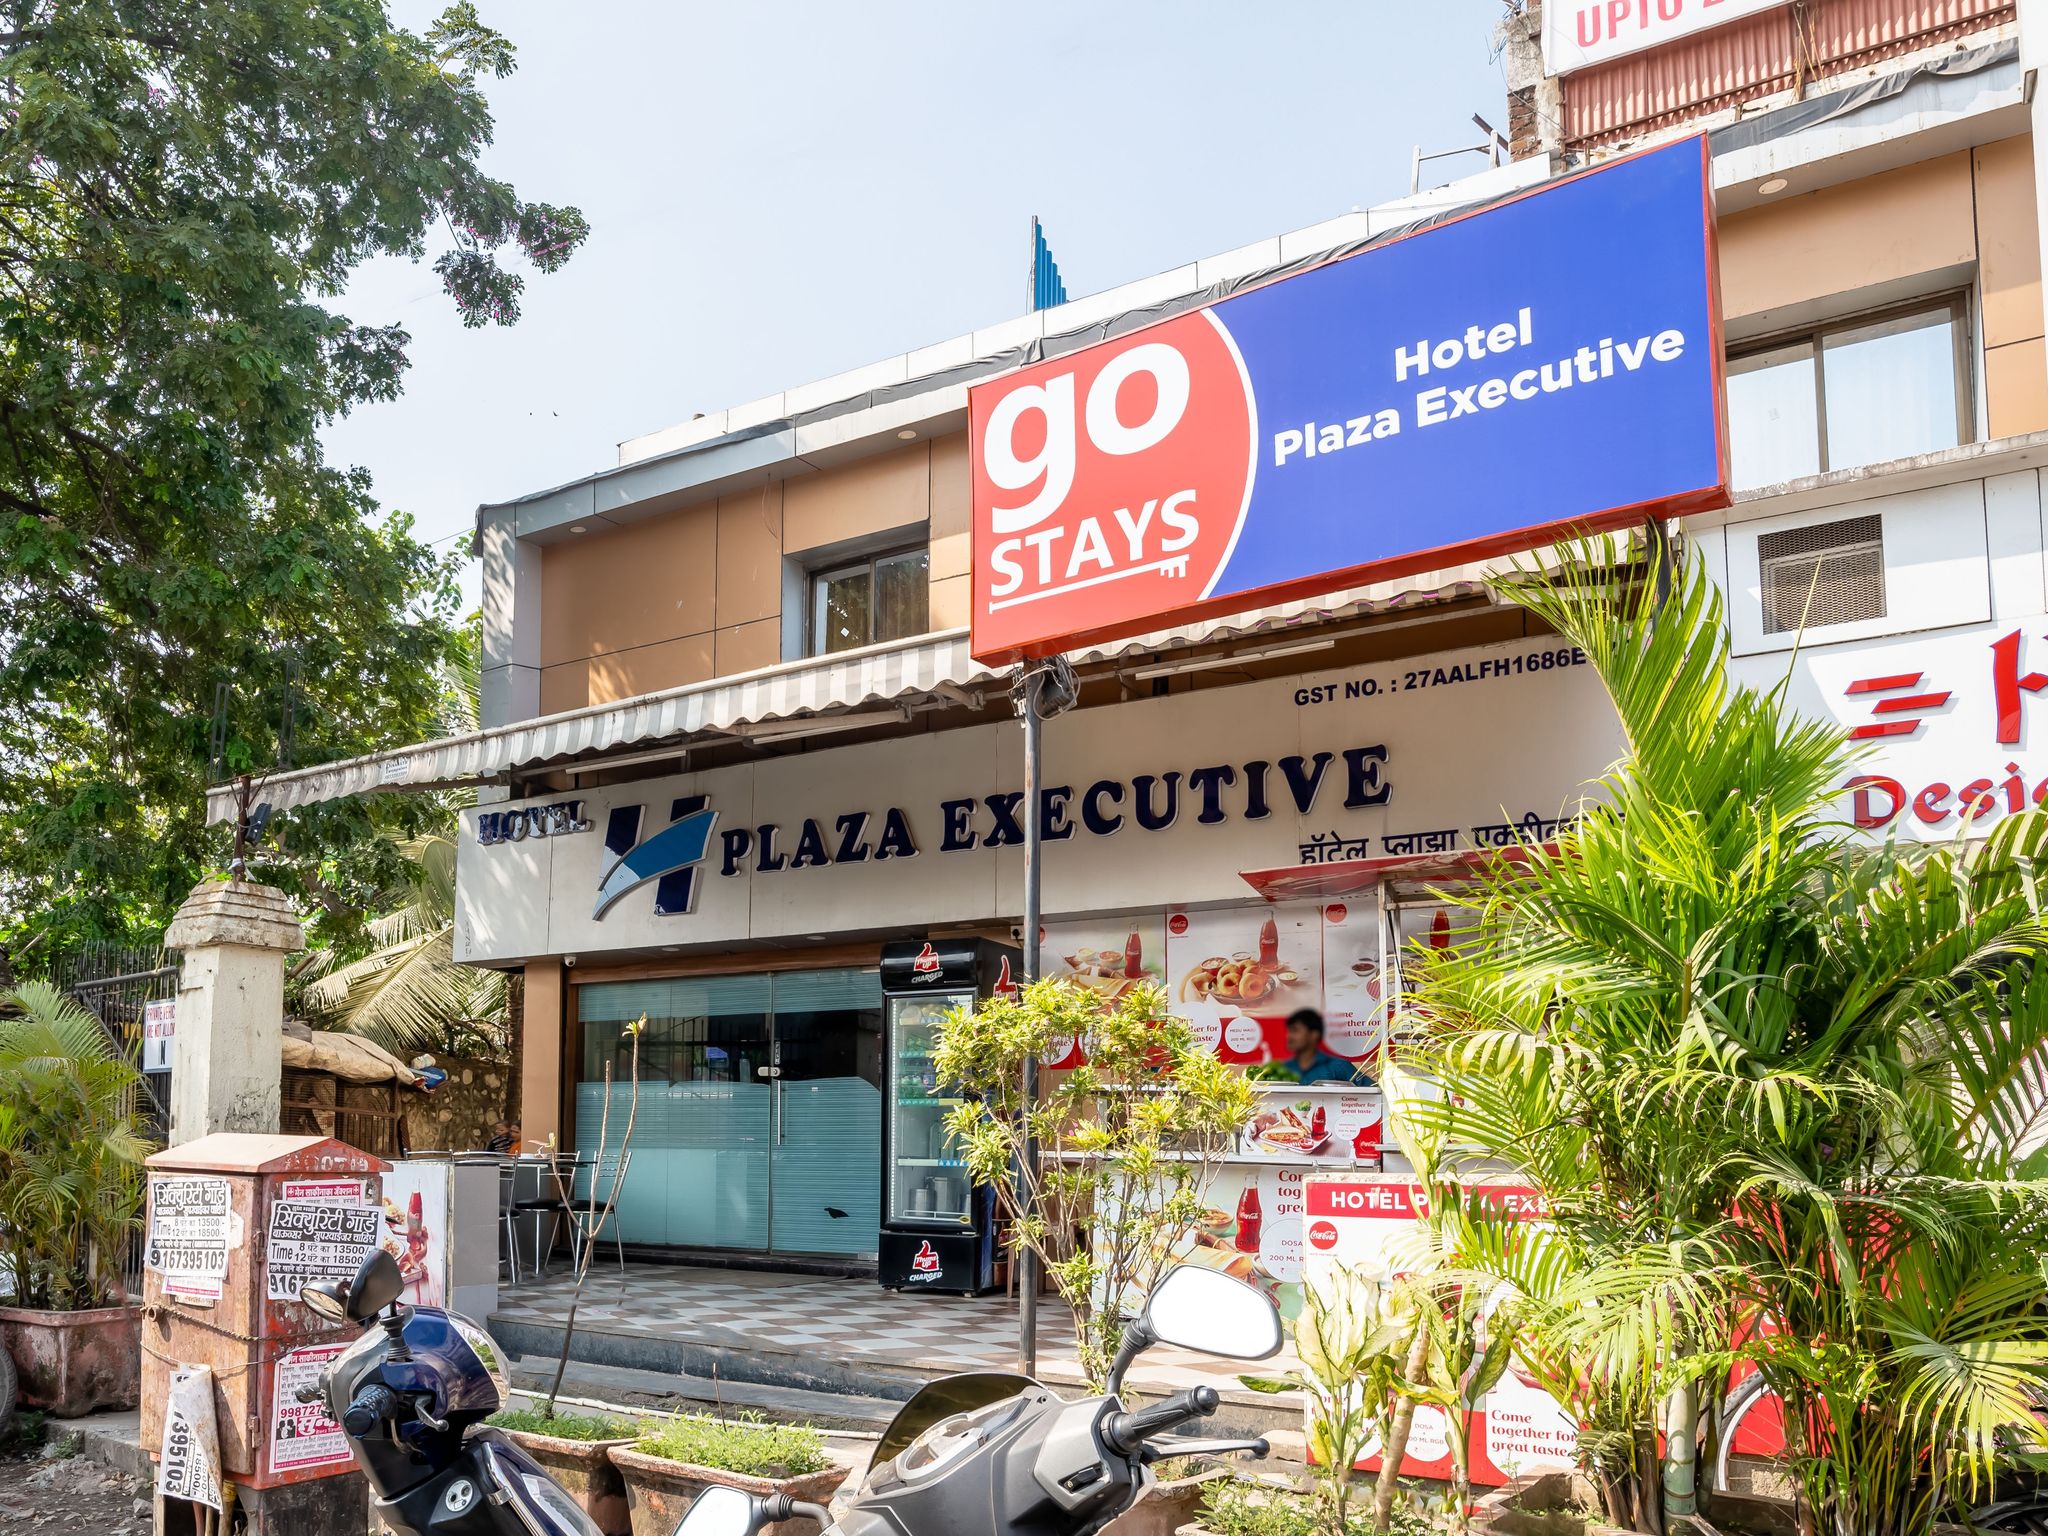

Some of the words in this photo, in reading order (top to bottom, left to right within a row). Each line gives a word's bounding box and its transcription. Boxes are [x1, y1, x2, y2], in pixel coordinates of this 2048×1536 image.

[1395, 308, 1533, 382] Hotel
[1274, 409, 1401, 467] Plaza
[1416, 329, 1685, 428] Executive
[983, 342, 1191, 534] go
[989, 490, 1199, 596] STAYS
[1294, 684, 1337, 706] GST
[1345, 679, 1383, 699] NO.
[1404, 647, 1587, 690] 27AALFH1686E
[1841, 762, 2048, 828] Desi
[477, 801, 593, 845] HOTEL
[720, 807, 920, 877] PLAZA
[940, 744, 1393, 853] EXECUTIVE
[1277, 1204, 1303, 1214] gre
[1331, 1191, 1407, 1210] HOTEL
[274, 1204, 344, 1235] सिक्युरिटी
[346, 1212, 377, 1233] गार्ड
[272, 1243, 293, 1260] Time
[299, 1242, 305, 1251] 8
[150, 1249, 225, 1270] 9167395103
[295, 1253, 306, 1262] 12
[334, 1255, 363, 1264] 18500
[280, 1404, 322, 1418] 998727
[1491, 1409, 1532, 1423] Come
[1492, 1426, 1552, 1439] together
[166, 1411, 190, 1493] 395103
[1491, 1441, 1529, 1453] great
